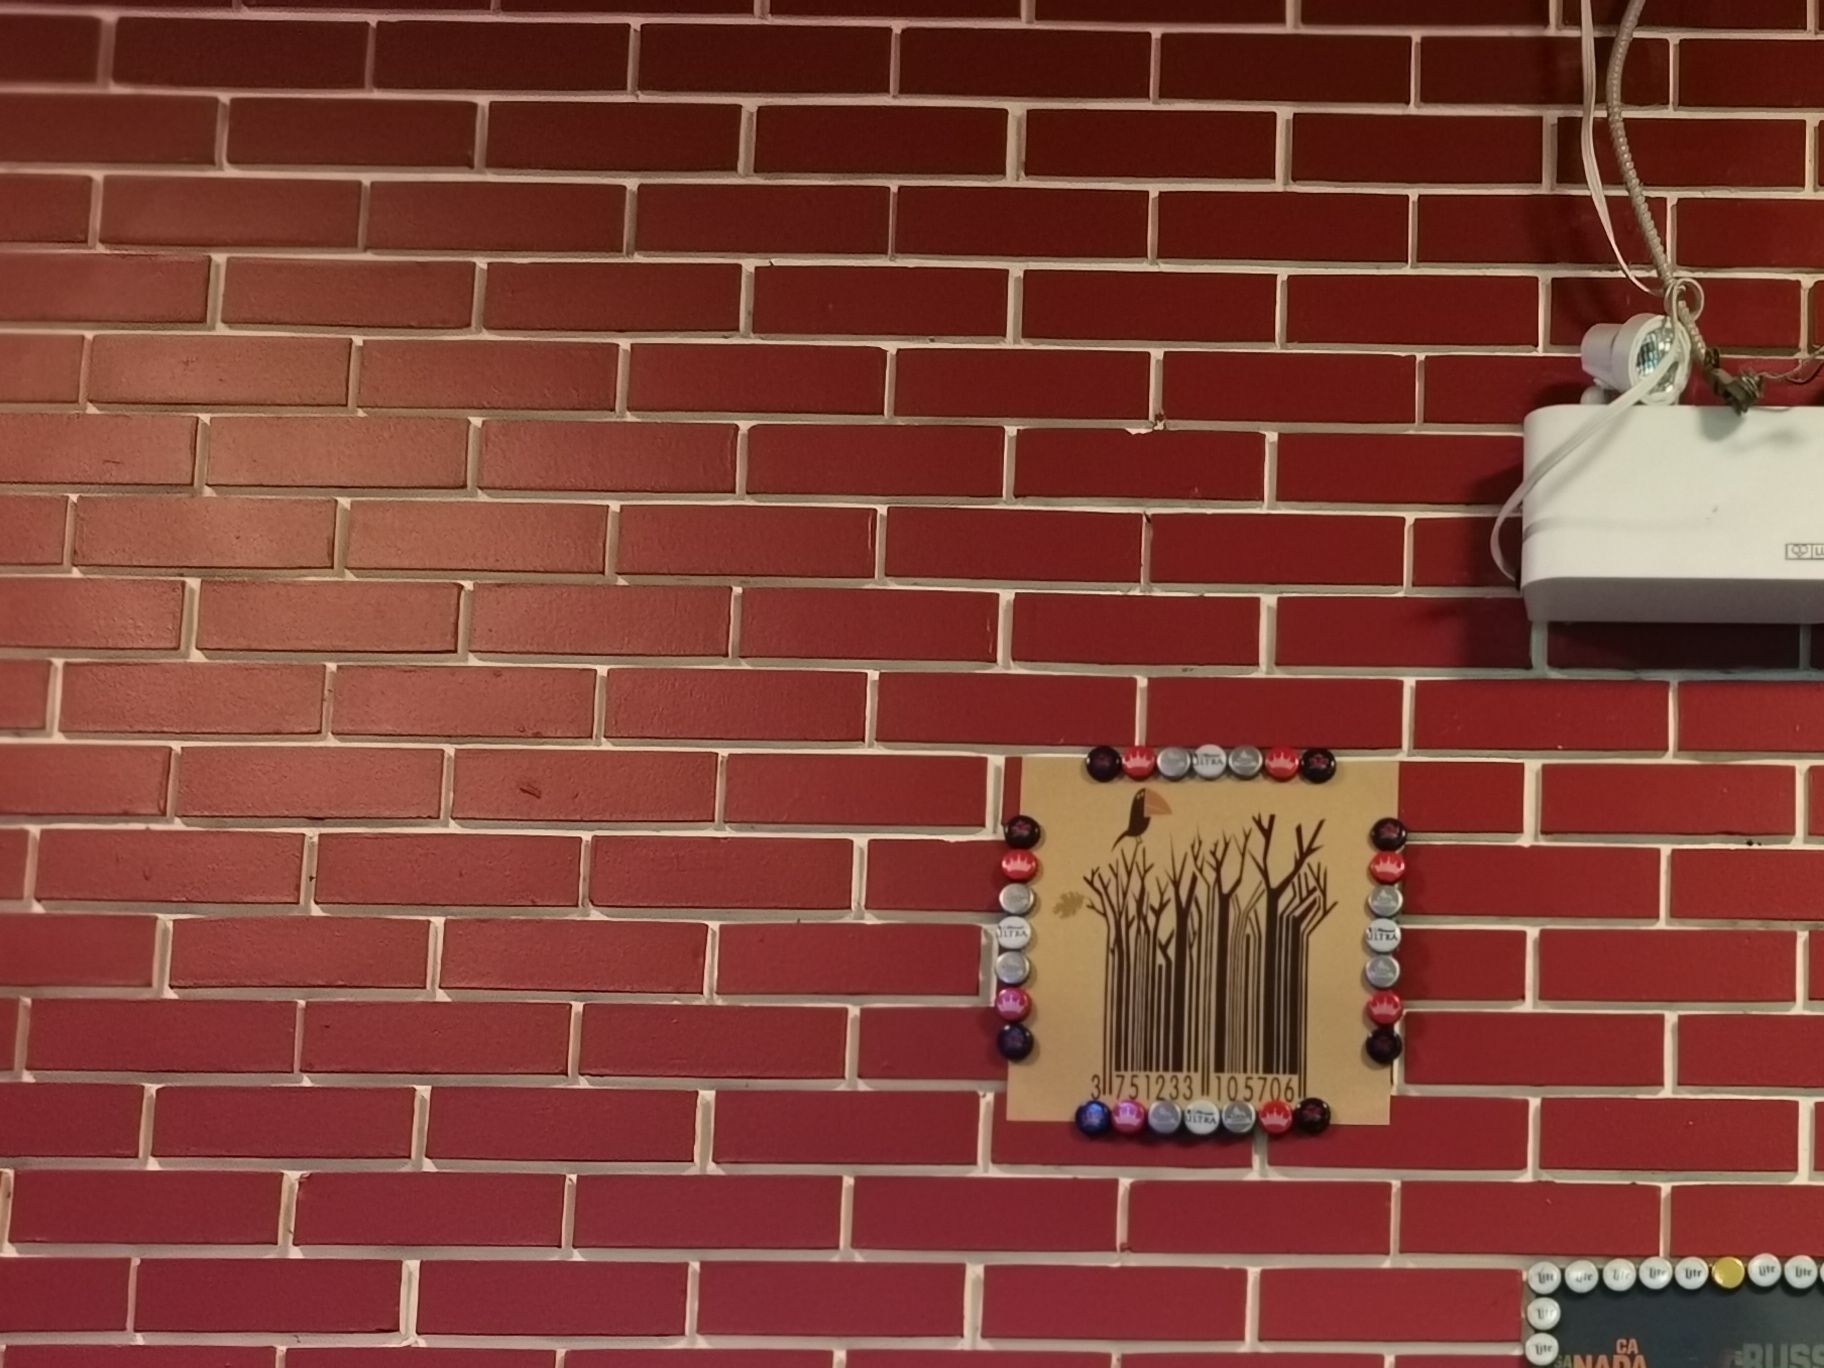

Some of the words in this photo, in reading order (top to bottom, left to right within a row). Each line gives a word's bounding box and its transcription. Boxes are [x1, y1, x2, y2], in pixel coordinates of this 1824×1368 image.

[1115, 1075, 1194, 1098] 751233
[1215, 1076, 1296, 1101] 105706
[1615, 1338, 1639, 1354] CA
